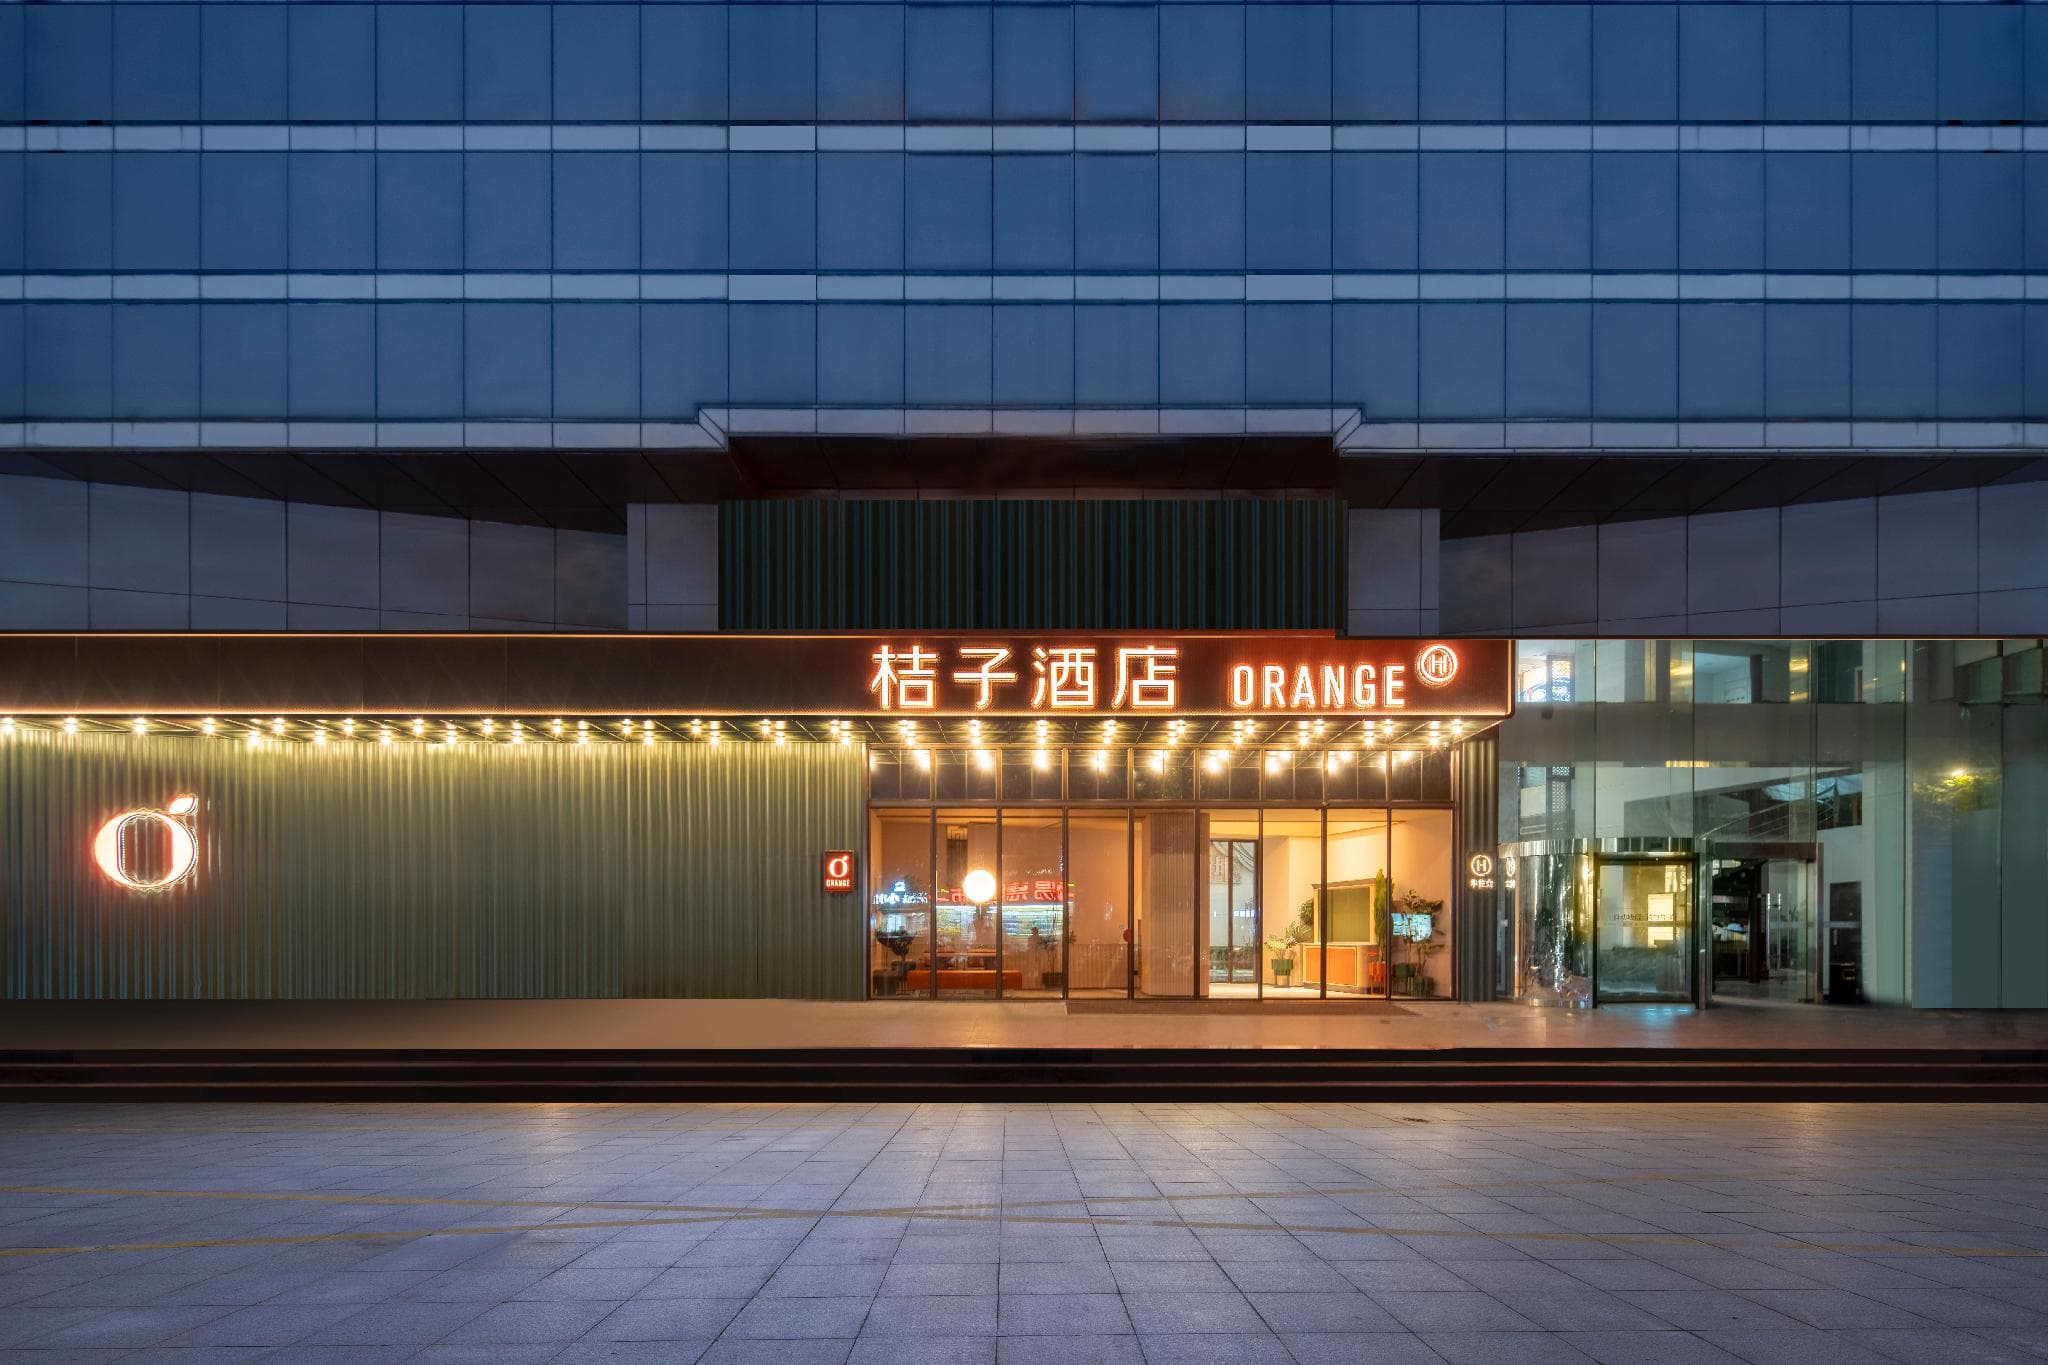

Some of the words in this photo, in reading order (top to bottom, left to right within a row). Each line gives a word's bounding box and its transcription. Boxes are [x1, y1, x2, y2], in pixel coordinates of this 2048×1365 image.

[871, 644, 1179, 709] 桔子酒店
[1232, 664, 1406, 708] ORANGE
[826, 879, 851, 887] ORANGE
